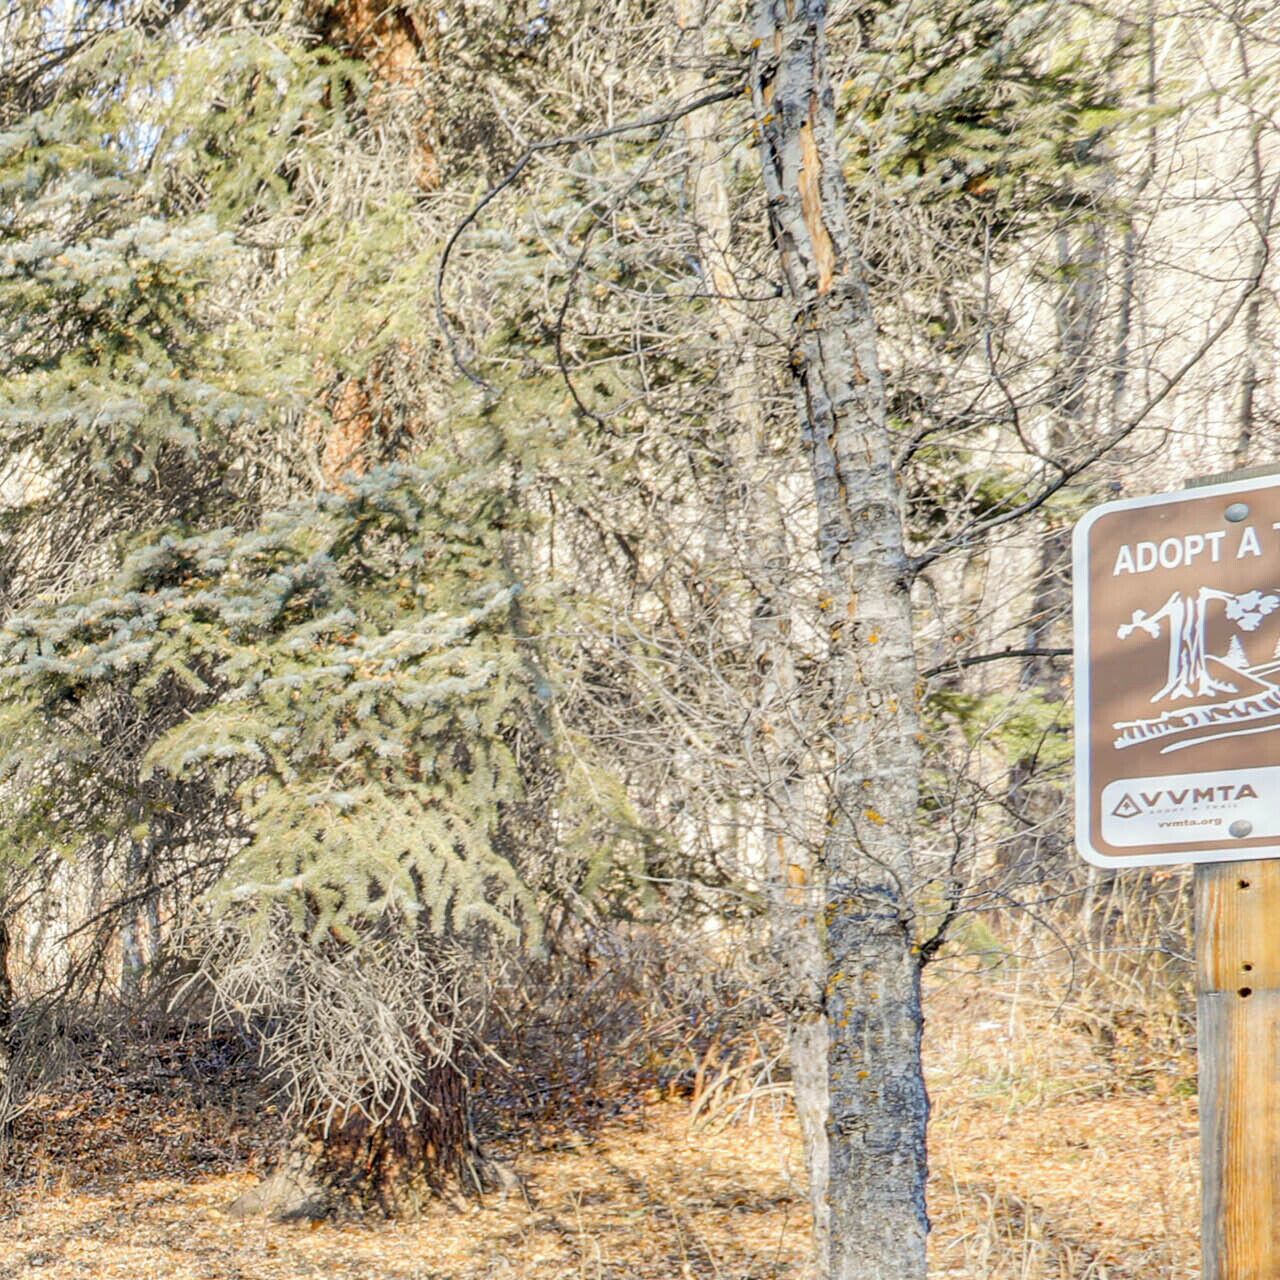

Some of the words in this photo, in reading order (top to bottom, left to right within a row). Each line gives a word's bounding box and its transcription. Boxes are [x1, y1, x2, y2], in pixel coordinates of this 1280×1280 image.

[1112, 529, 1227, 577] ADOPT
[1236, 525, 1262, 560] A
[1139, 783, 1259, 808] VVMTA
[1157, 817, 1223, 829] vvmta.org
